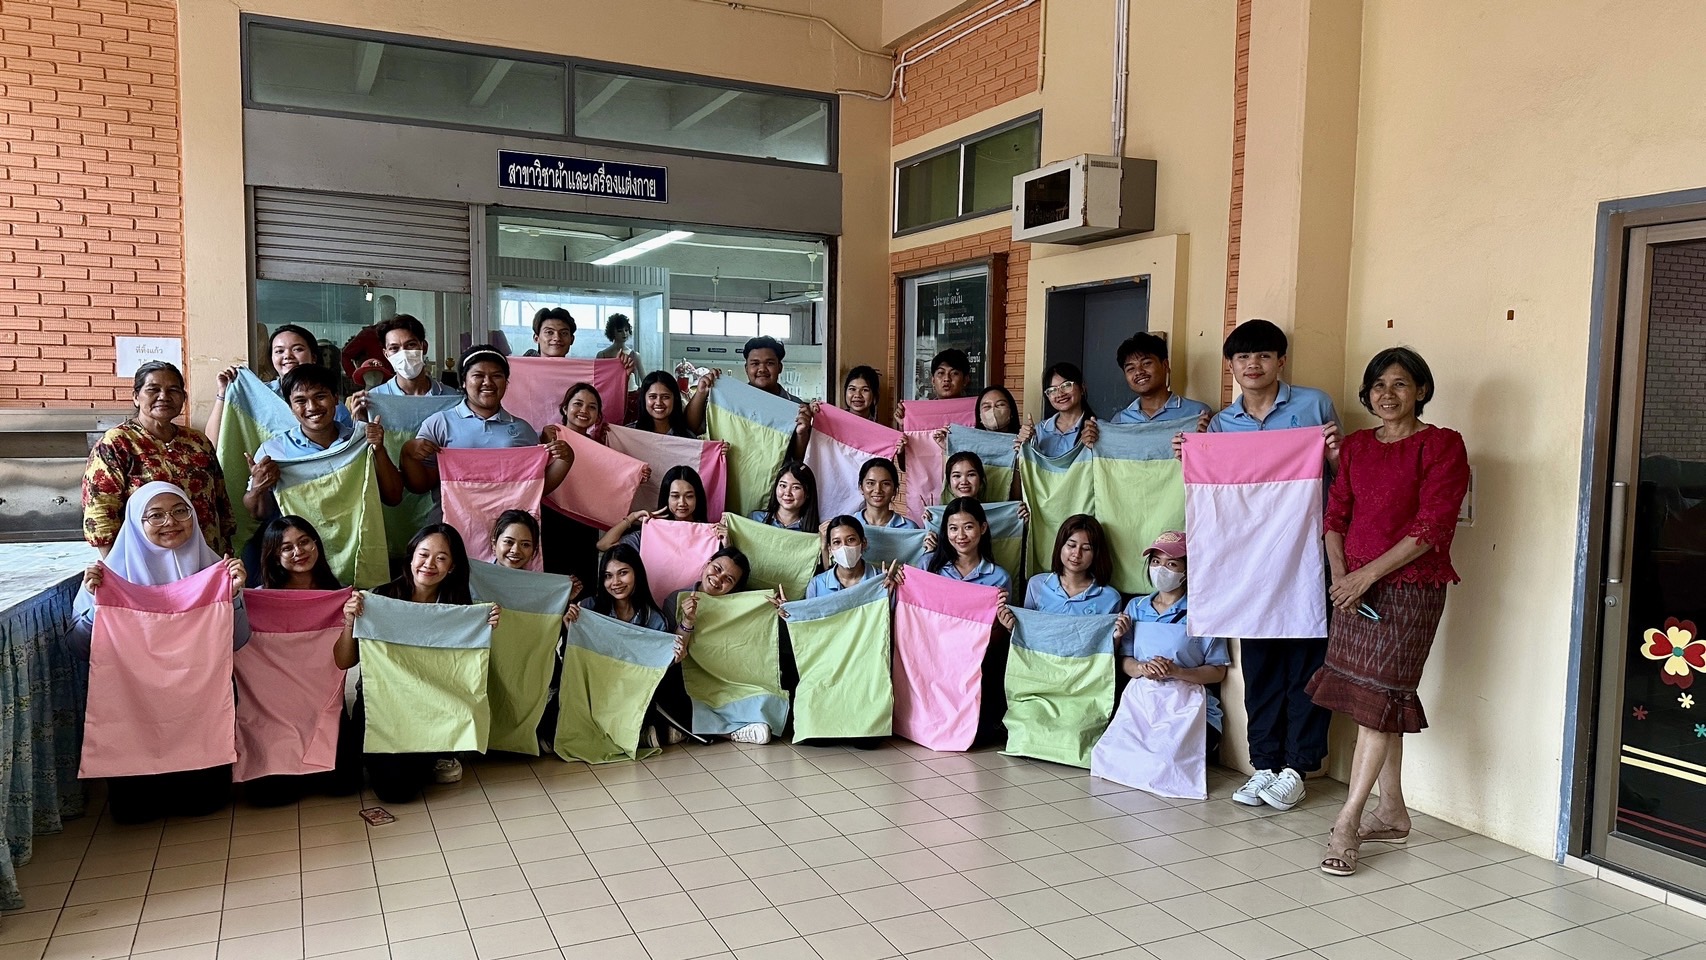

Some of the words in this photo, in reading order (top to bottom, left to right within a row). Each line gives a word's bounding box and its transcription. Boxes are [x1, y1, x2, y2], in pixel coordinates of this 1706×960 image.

[508, 158, 656, 198] สาขาวิชาผ้าและเครื่องแต่งกาย
